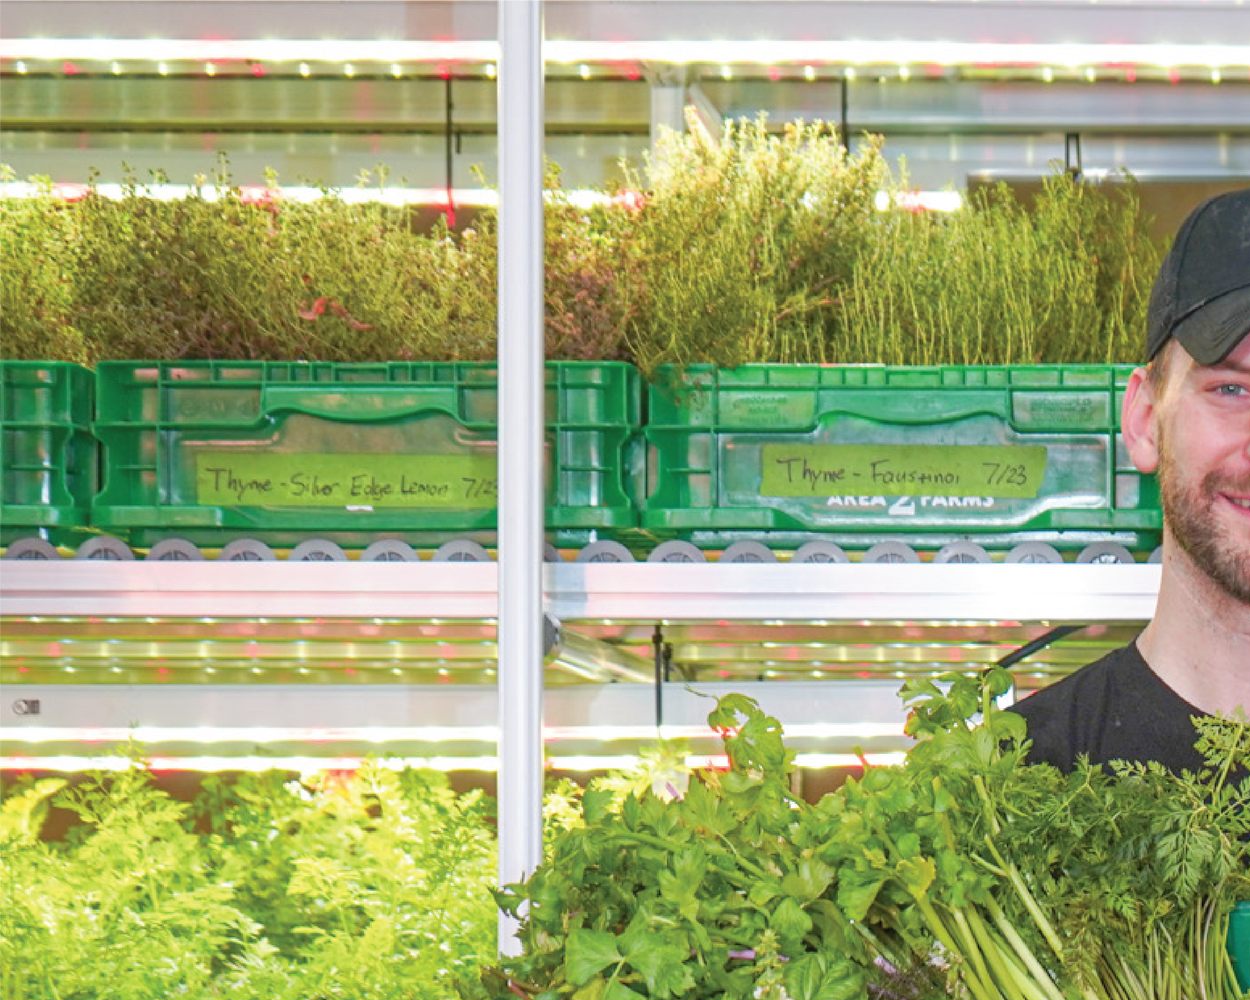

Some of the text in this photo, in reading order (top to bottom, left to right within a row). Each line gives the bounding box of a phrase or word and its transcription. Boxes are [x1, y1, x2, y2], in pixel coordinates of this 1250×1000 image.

[206, 467, 273, 502] Thyme
[351, 473, 393, 501] Edge
[401, 474, 449, 497] Lemon
[776, 457, 846, 492] Thyme
[982, 462, 1028, 486] 7/23
